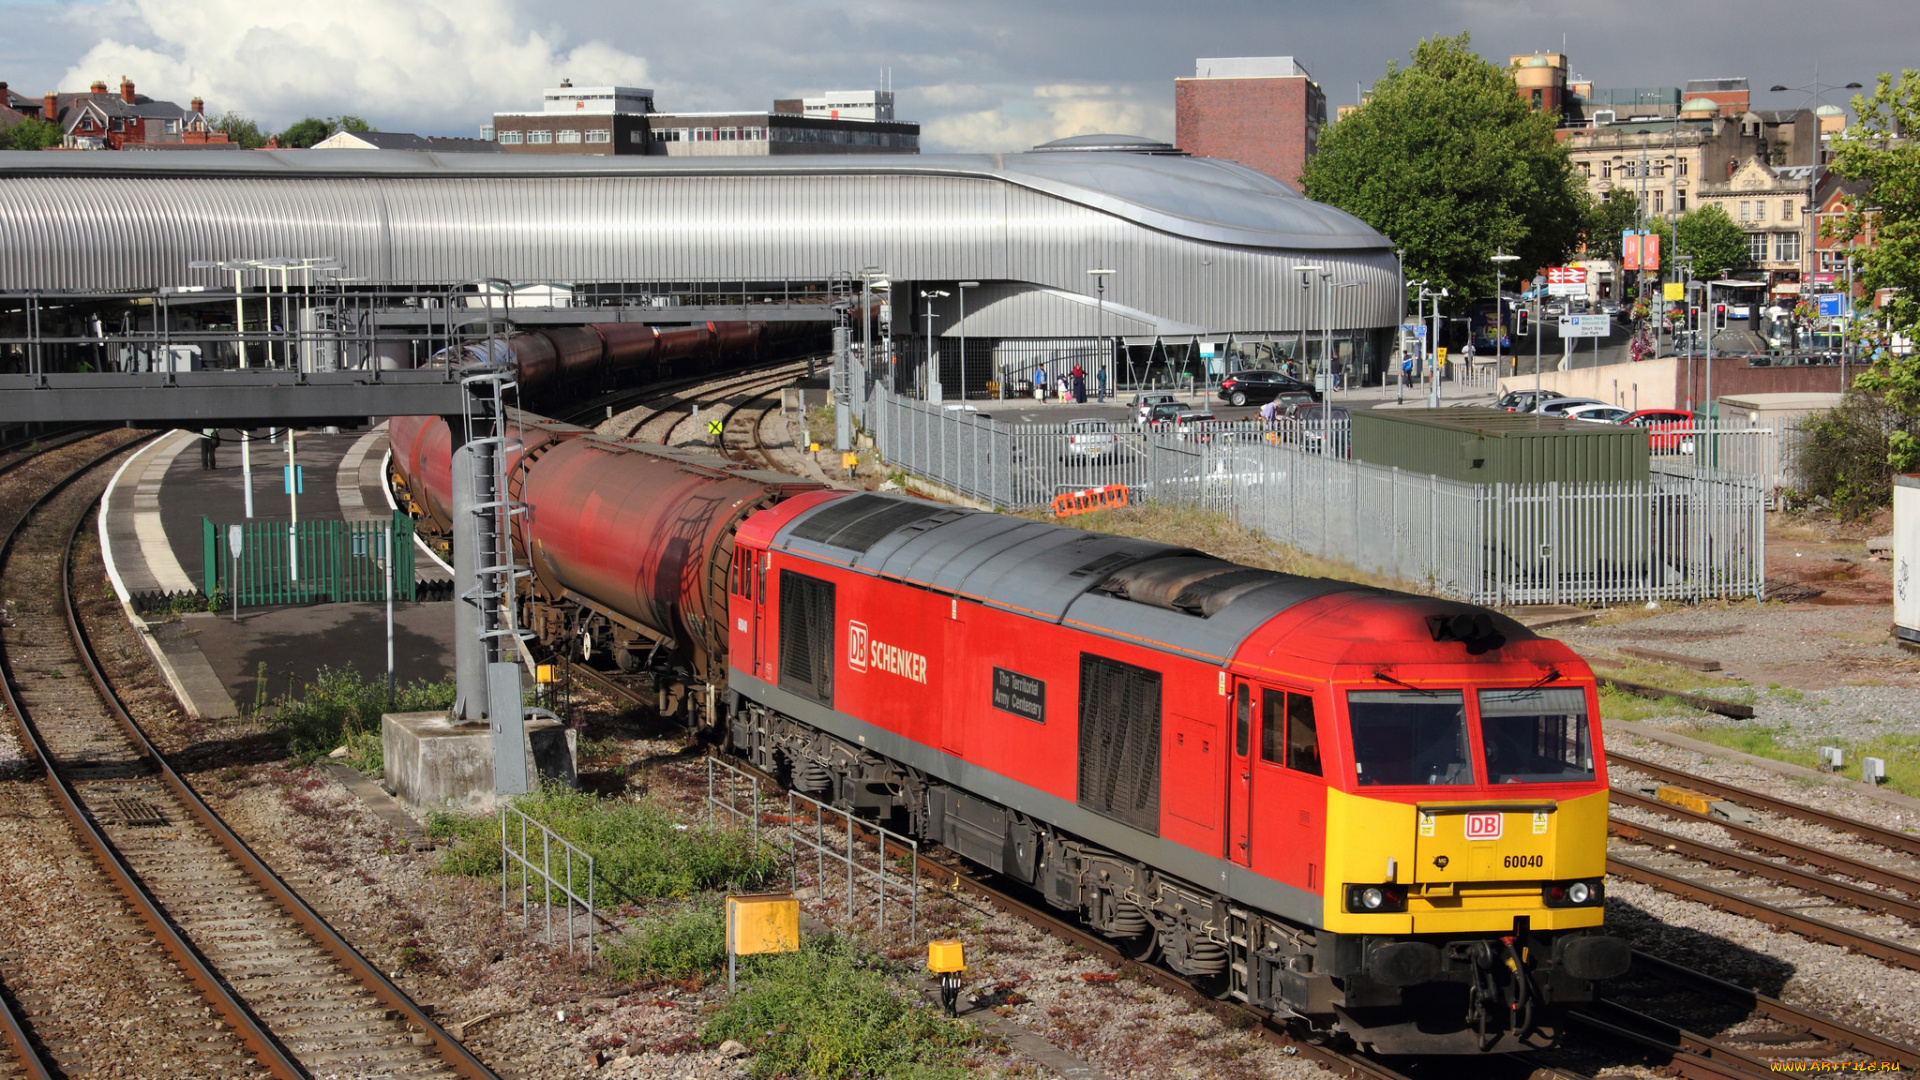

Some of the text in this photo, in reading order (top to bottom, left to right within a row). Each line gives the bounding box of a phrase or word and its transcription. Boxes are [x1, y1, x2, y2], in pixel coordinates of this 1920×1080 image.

[851, 629, 927, 685] DB SCHENKER
[999, 670, 1039, 697] The Territorial
[994, 688, 1043, 720] Army Centenary
[1470, 816, 1496, 833] DB
[1503, 855, 1543, 868] 60040
